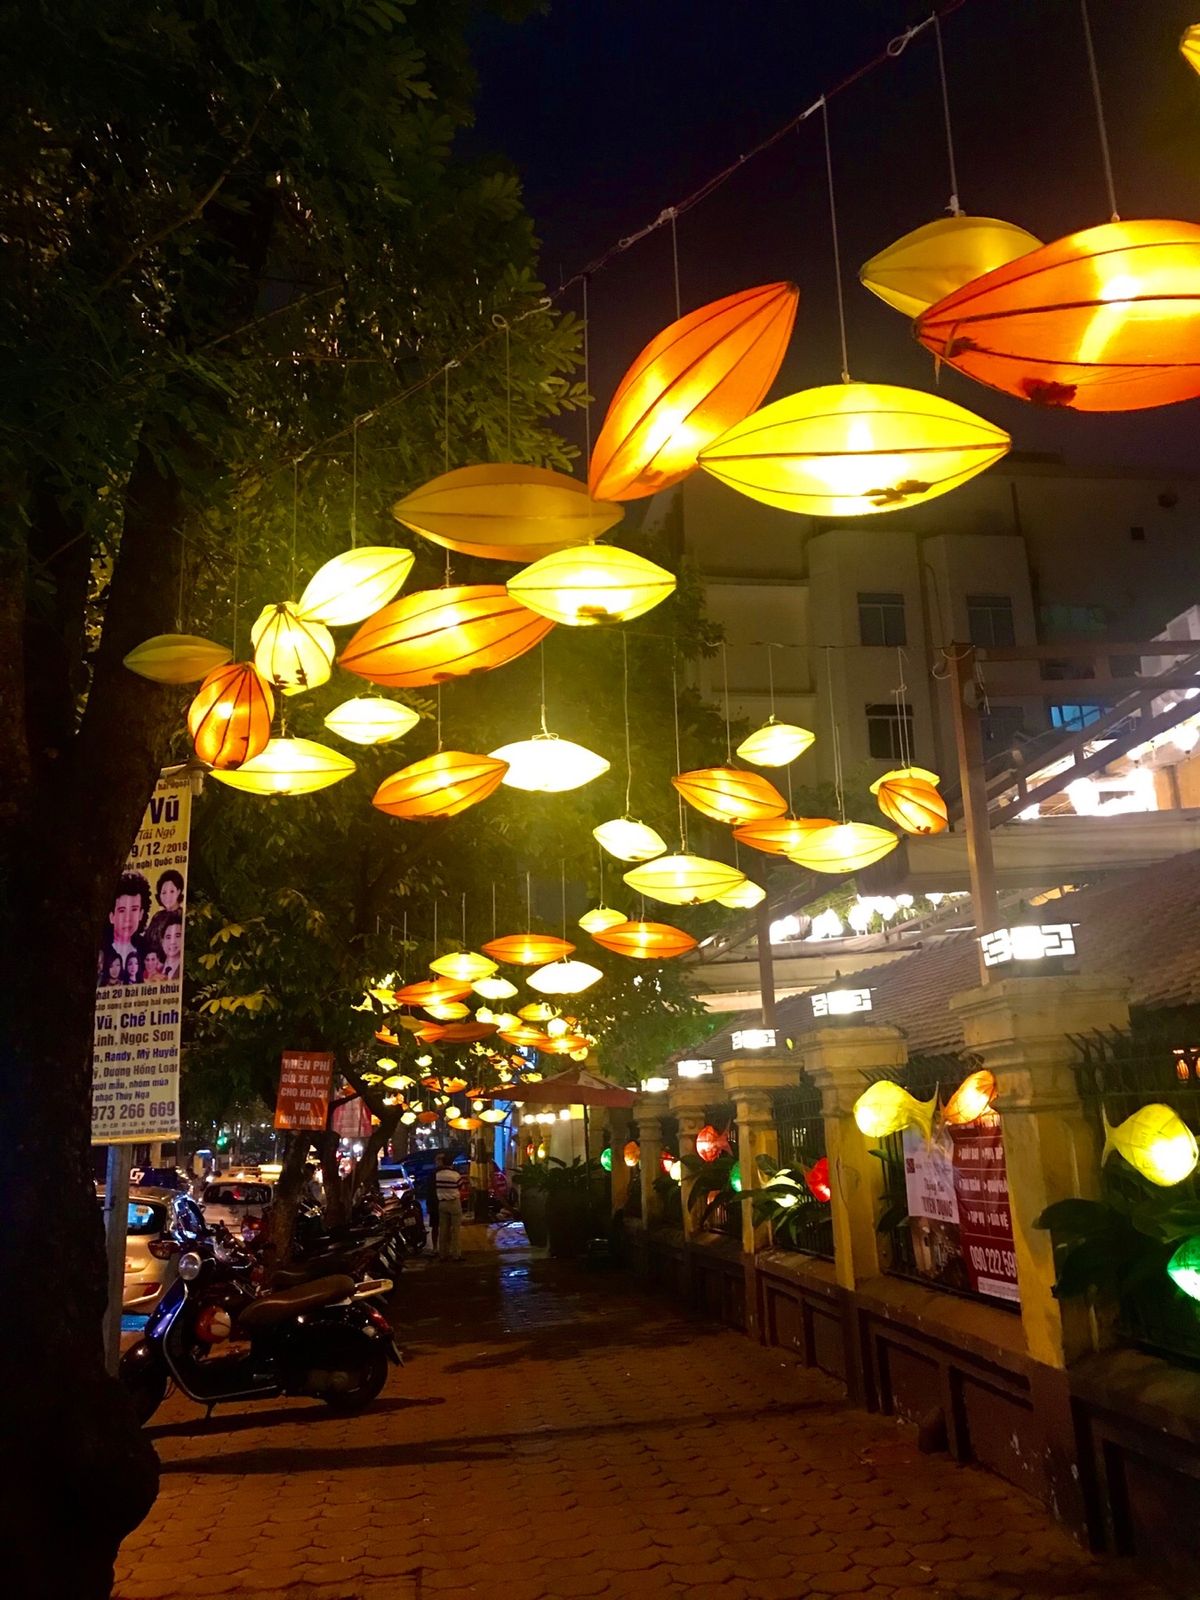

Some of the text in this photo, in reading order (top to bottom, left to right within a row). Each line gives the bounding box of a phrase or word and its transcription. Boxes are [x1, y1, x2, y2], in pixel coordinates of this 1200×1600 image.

[149, 795, 180, 825] Vũ
[112, 988, 123, 999] 20
[120, 1009, 148, 1029] Chế
[150, 1009, 179, 1026] Linh
[120, 1032, 149, 1047] Ngọc
[152, 1029, 175, 1042] Sơn
[298, 1074, 309, 1084] XE
[280, 1087, 298, 1097] CHO
[119, 1103, 145, 1120] 266
[149, 1100, 176, 1118] 669
[985, 1247, 1004, 1276] 222
